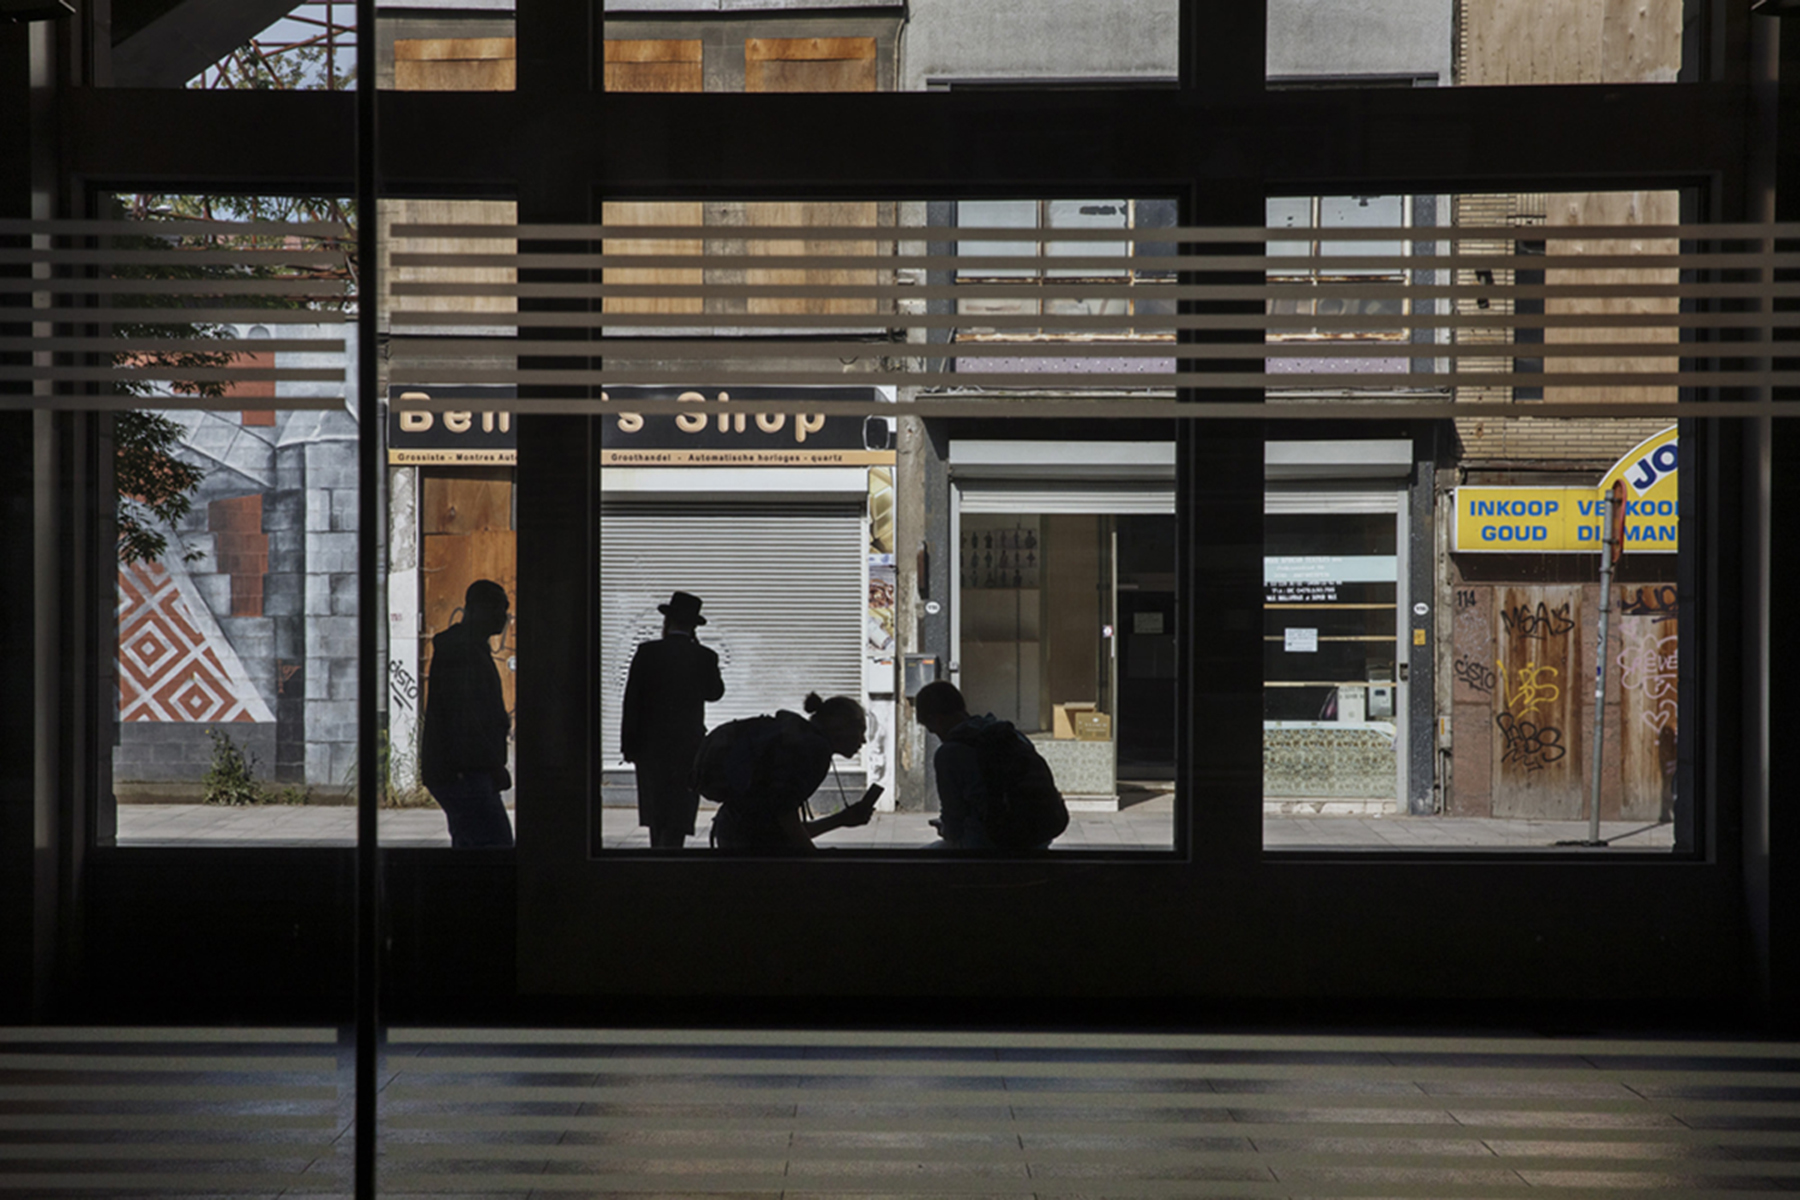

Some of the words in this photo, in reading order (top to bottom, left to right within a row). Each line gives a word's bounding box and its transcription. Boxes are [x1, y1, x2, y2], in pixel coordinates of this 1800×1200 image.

[675, 391, 826, 443] Shop
[397, 453, 445, 461] Grossiste
[456, 453, 495, 461] Montres
[611, 453, 671, 461] Groothandel
[688, 453, 754, 461] Automatische
[758, 453, 800, 463] horloges
[811, 453, 842, 463] quartz
[1470, 501, 1559, 516] INKOOP
[1577, 500, 1679, 516] VEKOO
[1481, 526, 1547, 541] GOUD
[1577, 525, 1676, 541] DIMAN
